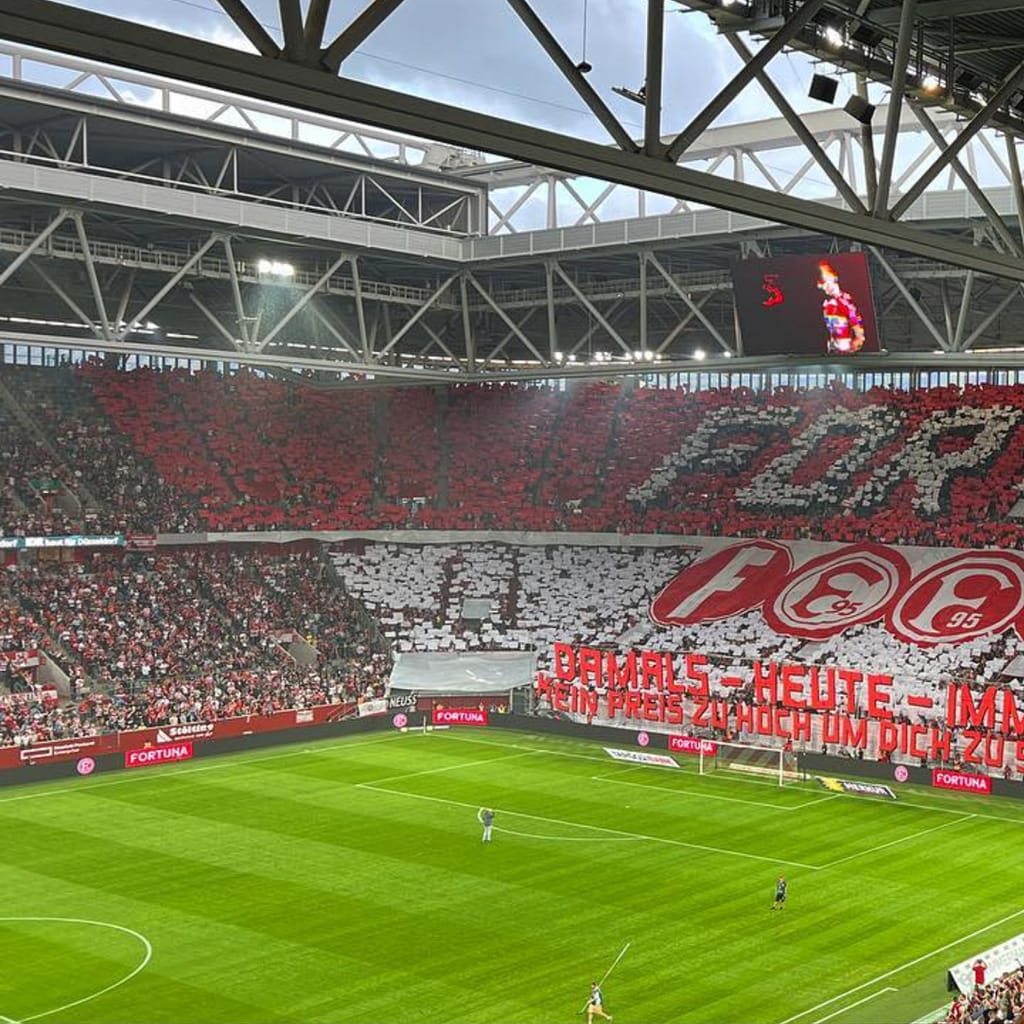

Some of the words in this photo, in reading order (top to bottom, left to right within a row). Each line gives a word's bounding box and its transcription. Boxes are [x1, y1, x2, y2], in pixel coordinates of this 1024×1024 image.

[831, 602, 862, 616] 95
[946, 611, 983, 628] 95
[554, 642, 710, 695] DAMALS
[754, 661, 894, 719] HEUTE
[437, 713, 484, 722] FORTUNA
[535, 673, 599, 716] KEIN
[607, 690, 684, 725] PREIS
[692, 696, 728, 730] ZU
[736, 703, 811, 742] HOCH
[822, 713, 867, 750] UM
[879, 721, 950, 762] DICH
[963, 730, 1003, 768] ZU
[672, 738, 714, 752] FORTUNA
[130, 745, 188, 763] FORTUNA
[936, 773, 987, 789] FORTUNA
